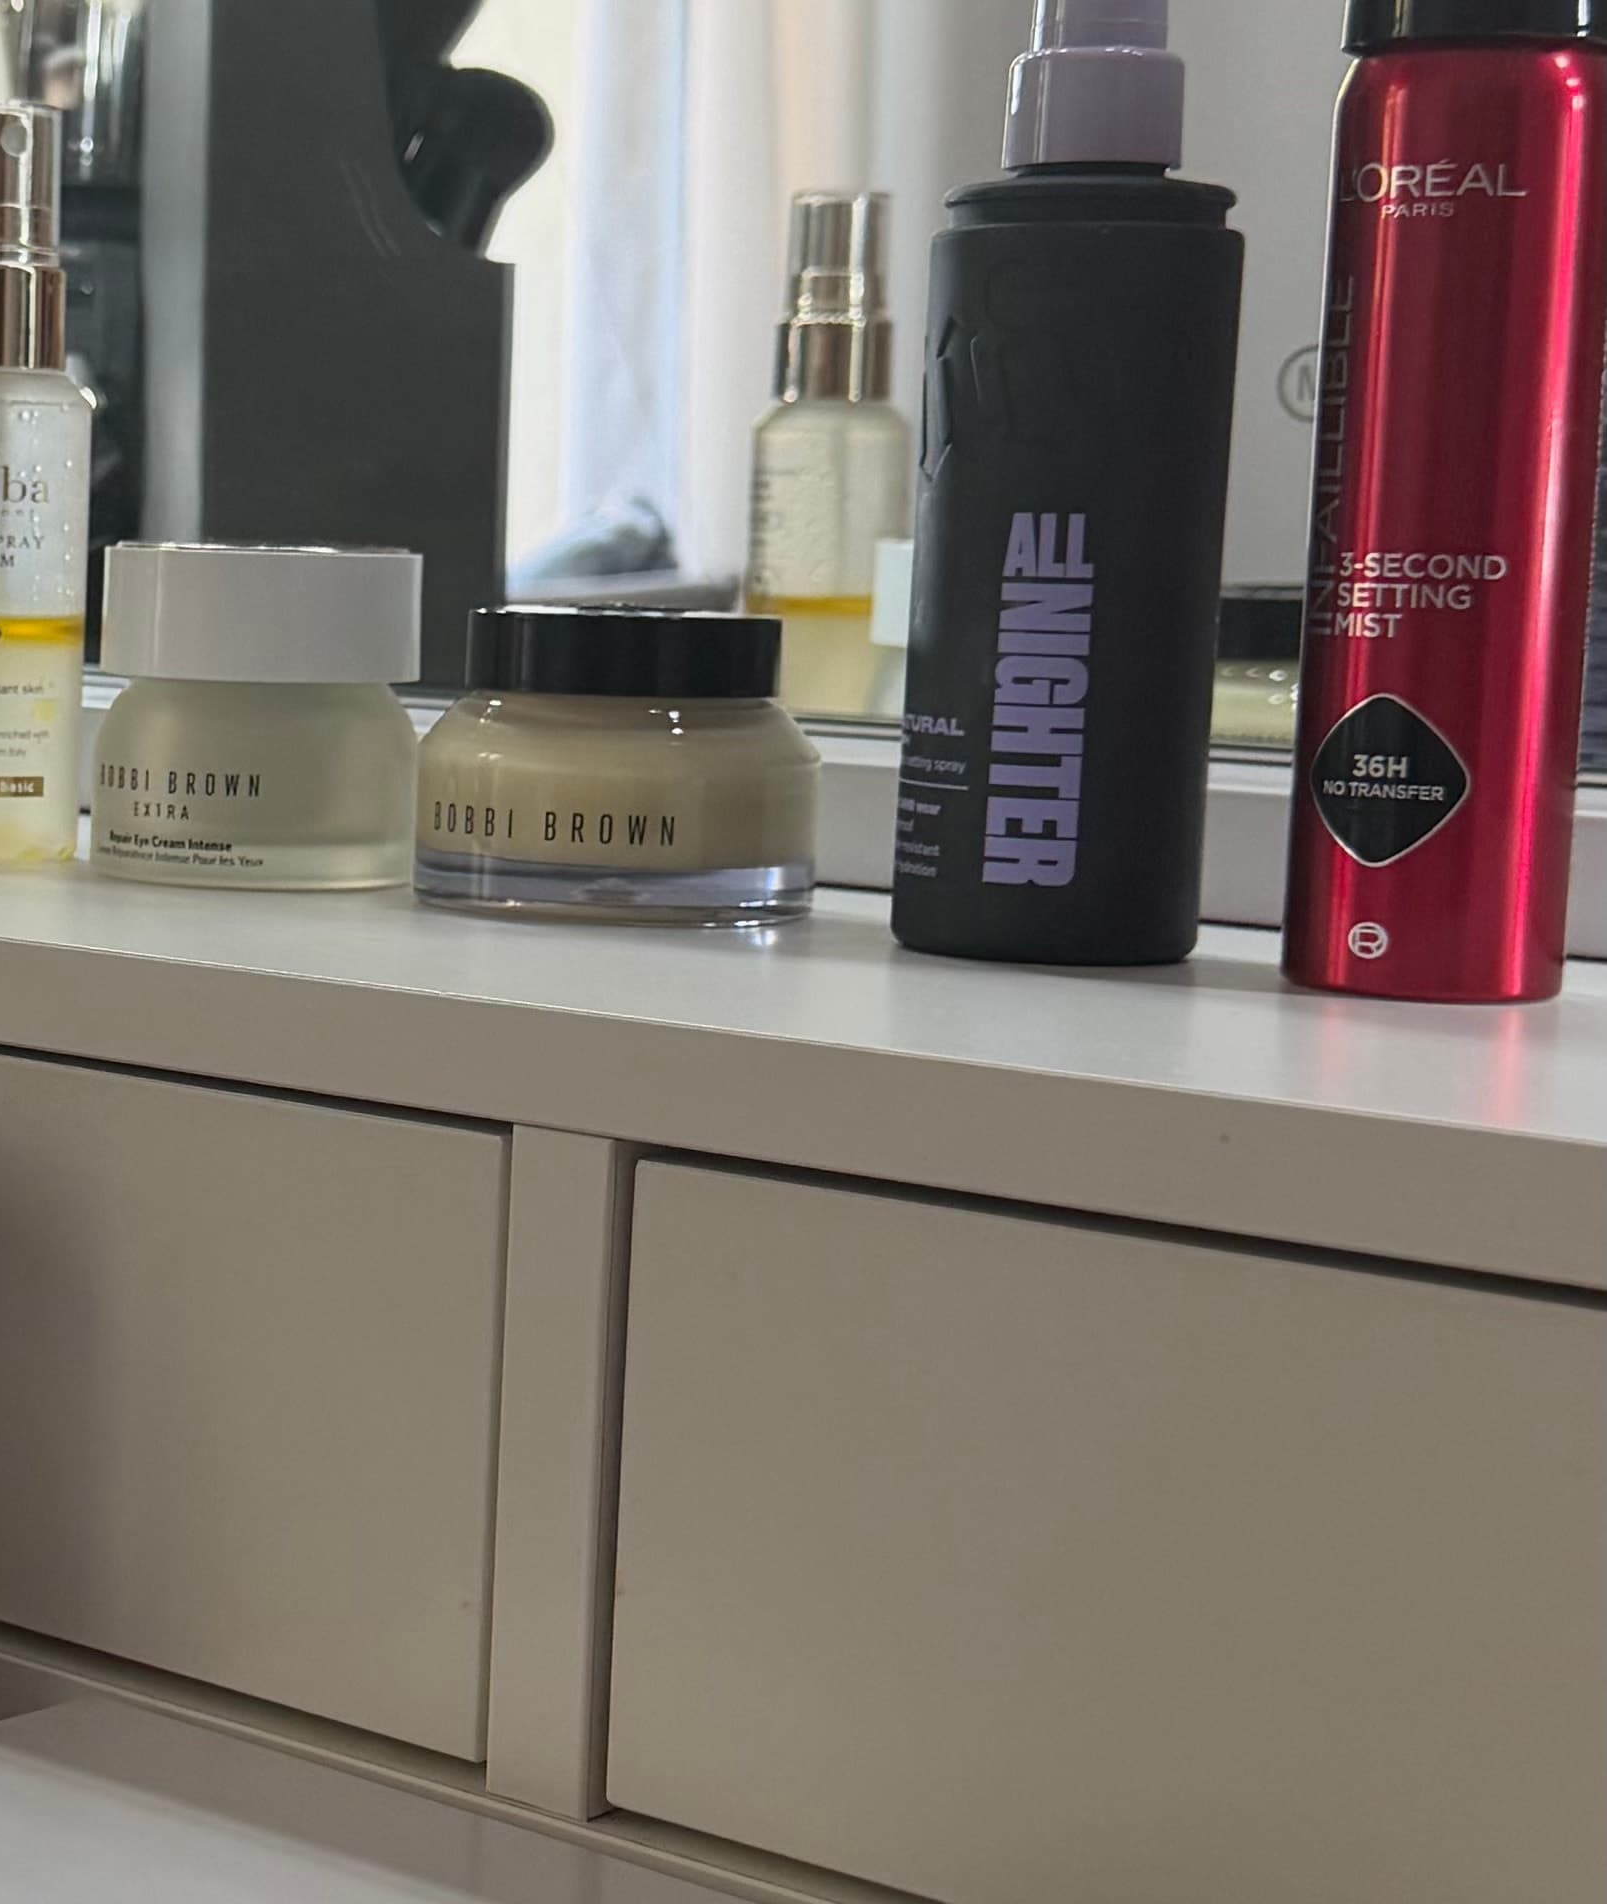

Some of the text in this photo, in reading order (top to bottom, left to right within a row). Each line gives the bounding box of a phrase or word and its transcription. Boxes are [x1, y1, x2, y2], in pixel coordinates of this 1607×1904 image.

[1381, 201, 1454, 218] PARIS
[1002, 512, 1094, 578] ALL
[1339, 552, 1508, 581] 3-SECOND
[1336, 582, 1473, 610] SETTING
[1331, 612, 1402, 639] MIST
[903, 713, 965, 736] TURAL
[982, 582, 1093, 887] NIGHTER
[1353, 754, 1408, 779] 36H
[168, 771, 261, 797] BROWN
[1323, 778, 1444, 801] NO TRANSFER
[133, 801, 190, 820] EXTRA
[434, 801, 678, 847] BOBBI BROWN
[151, 836, 186, 849] Cream
[188, 838, 232, 852] Intense
